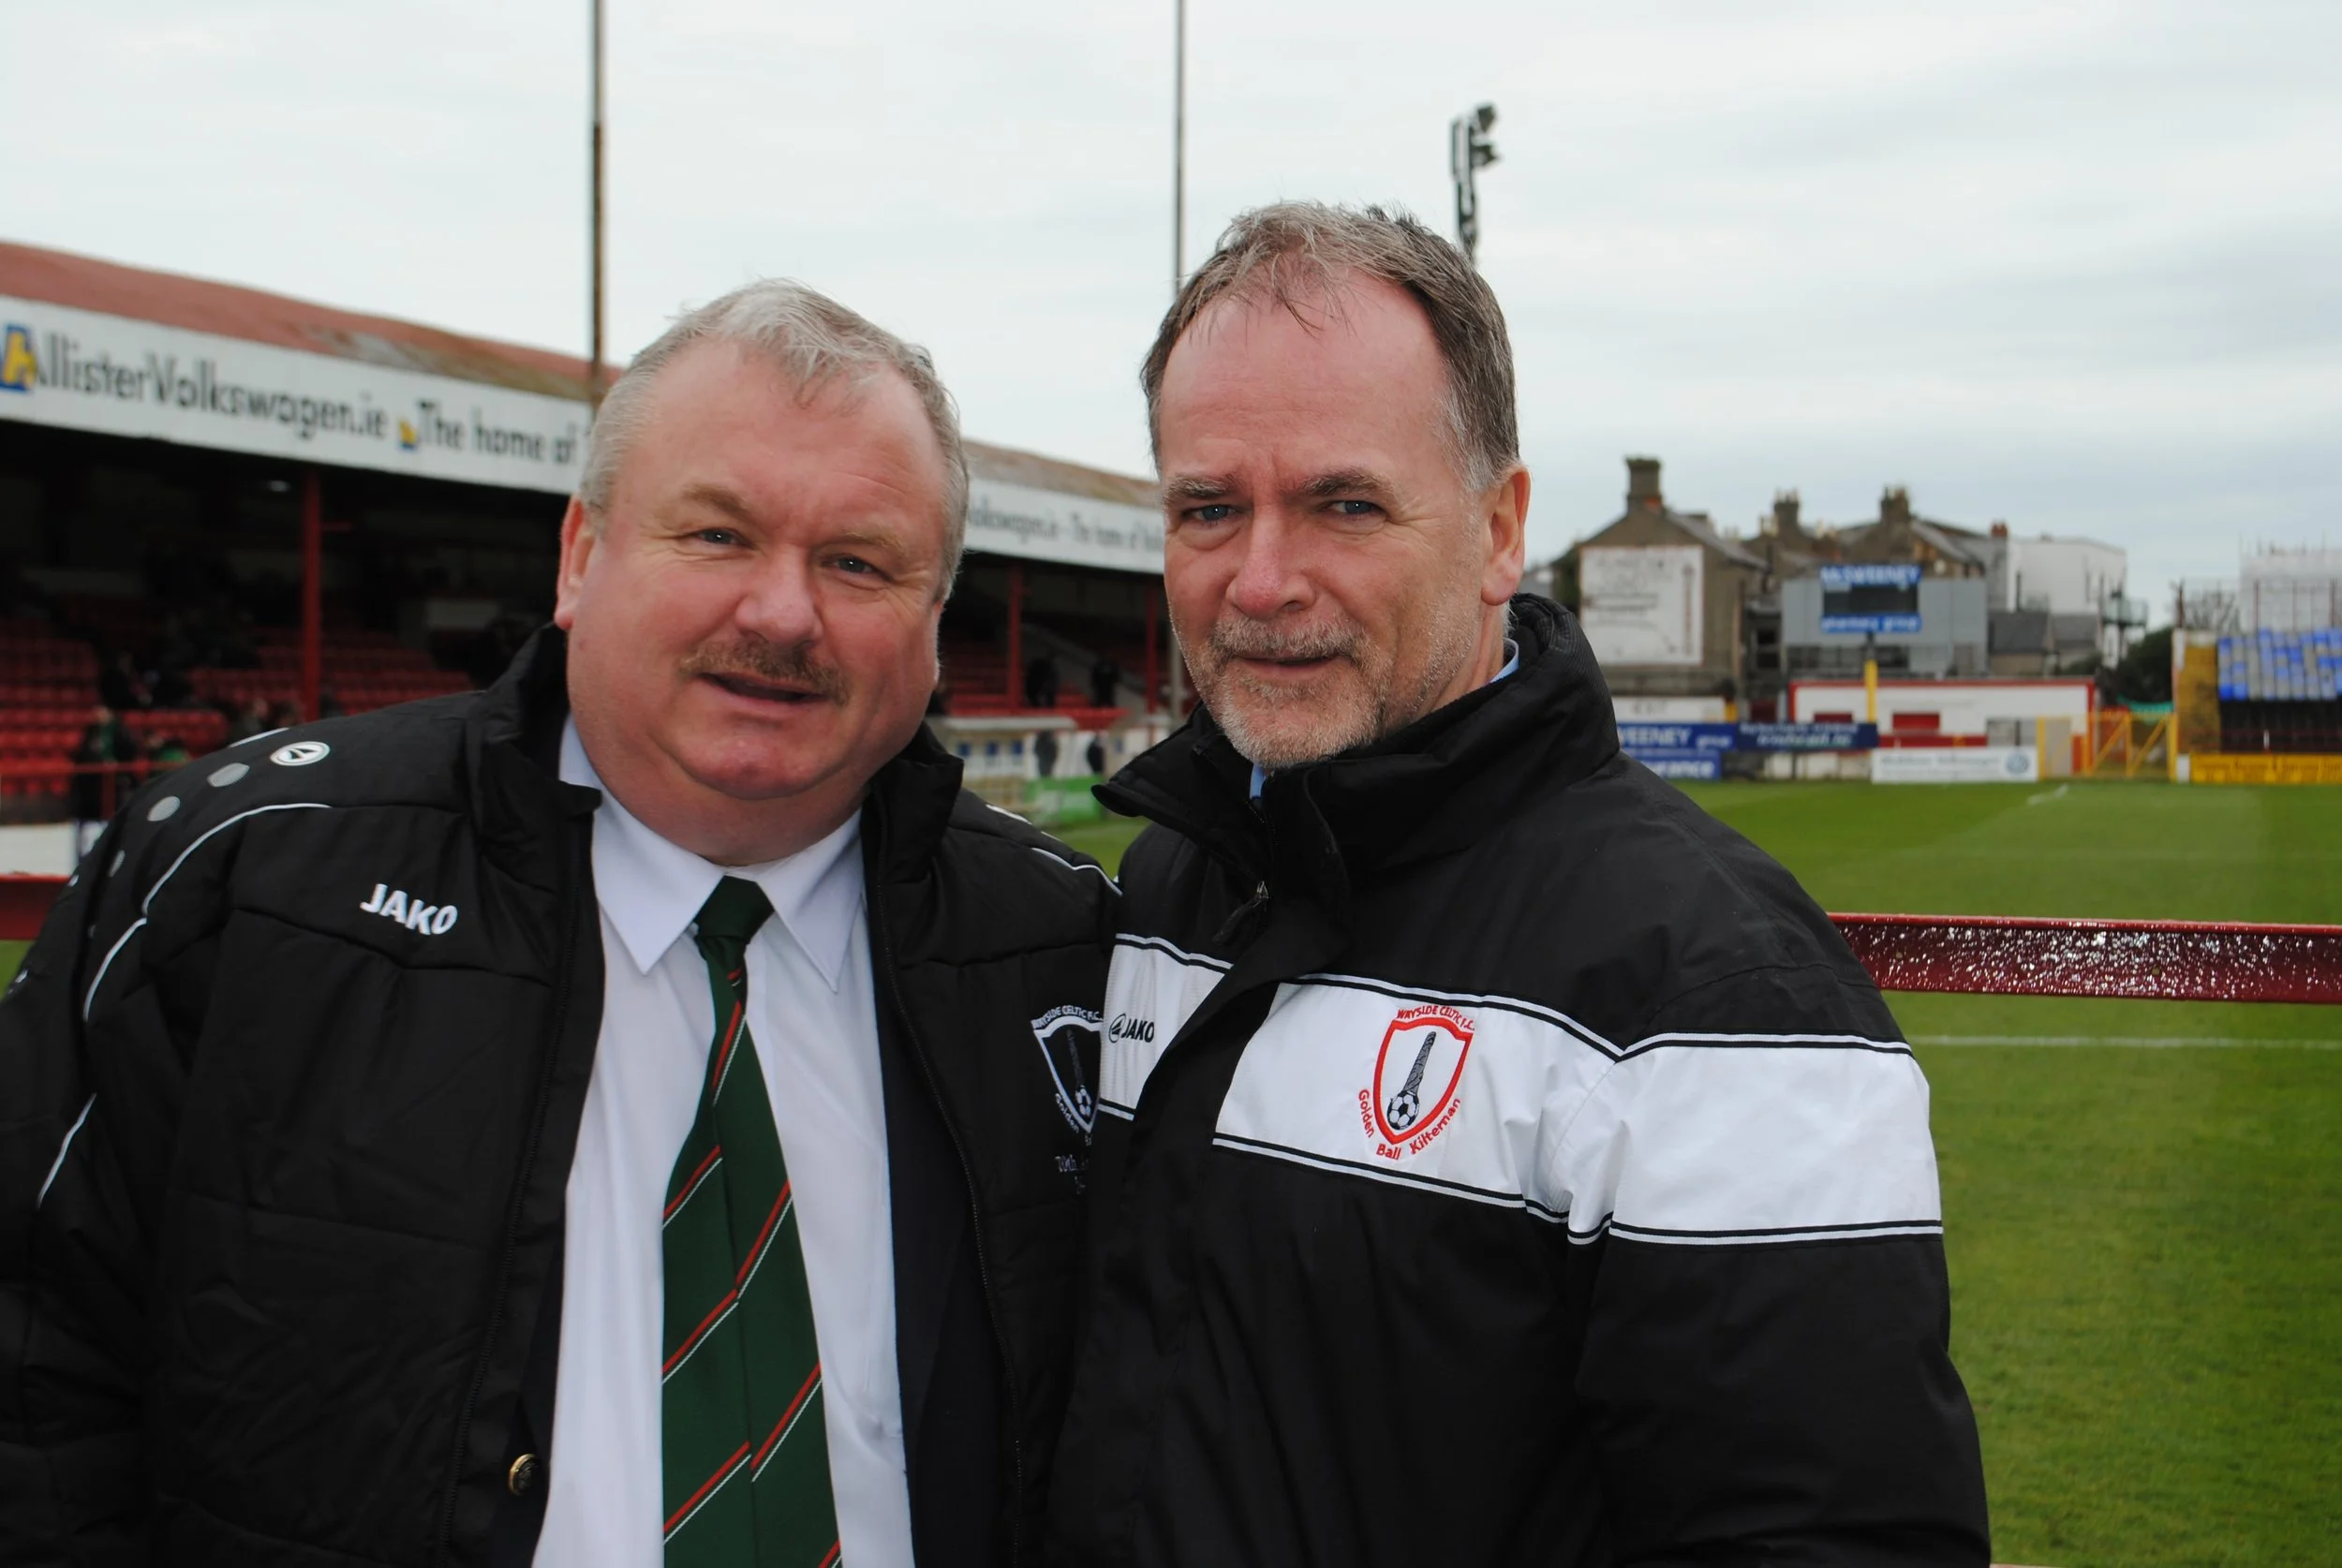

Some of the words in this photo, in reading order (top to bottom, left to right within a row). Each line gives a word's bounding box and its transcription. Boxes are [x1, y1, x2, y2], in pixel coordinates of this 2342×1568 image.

[419, 397, 463, 450] The
[476, 407, 543, 461] home
[360, 883, 458, 935] JAKO
[1030, 1007, 1061, 1028] WAYSIDE
[1061, 1005, 1087, 1018] CELTIC
[1121, 1018, 1154, 1043] JAKO
[1397, 1005, 1438, 1019] WAYSIDE
[1440, 1006, 1462, 1022] CELTIC
[1358, 1088, 1375, 1138] Golden
[1375, 1143, 1401, 1161] Ball
